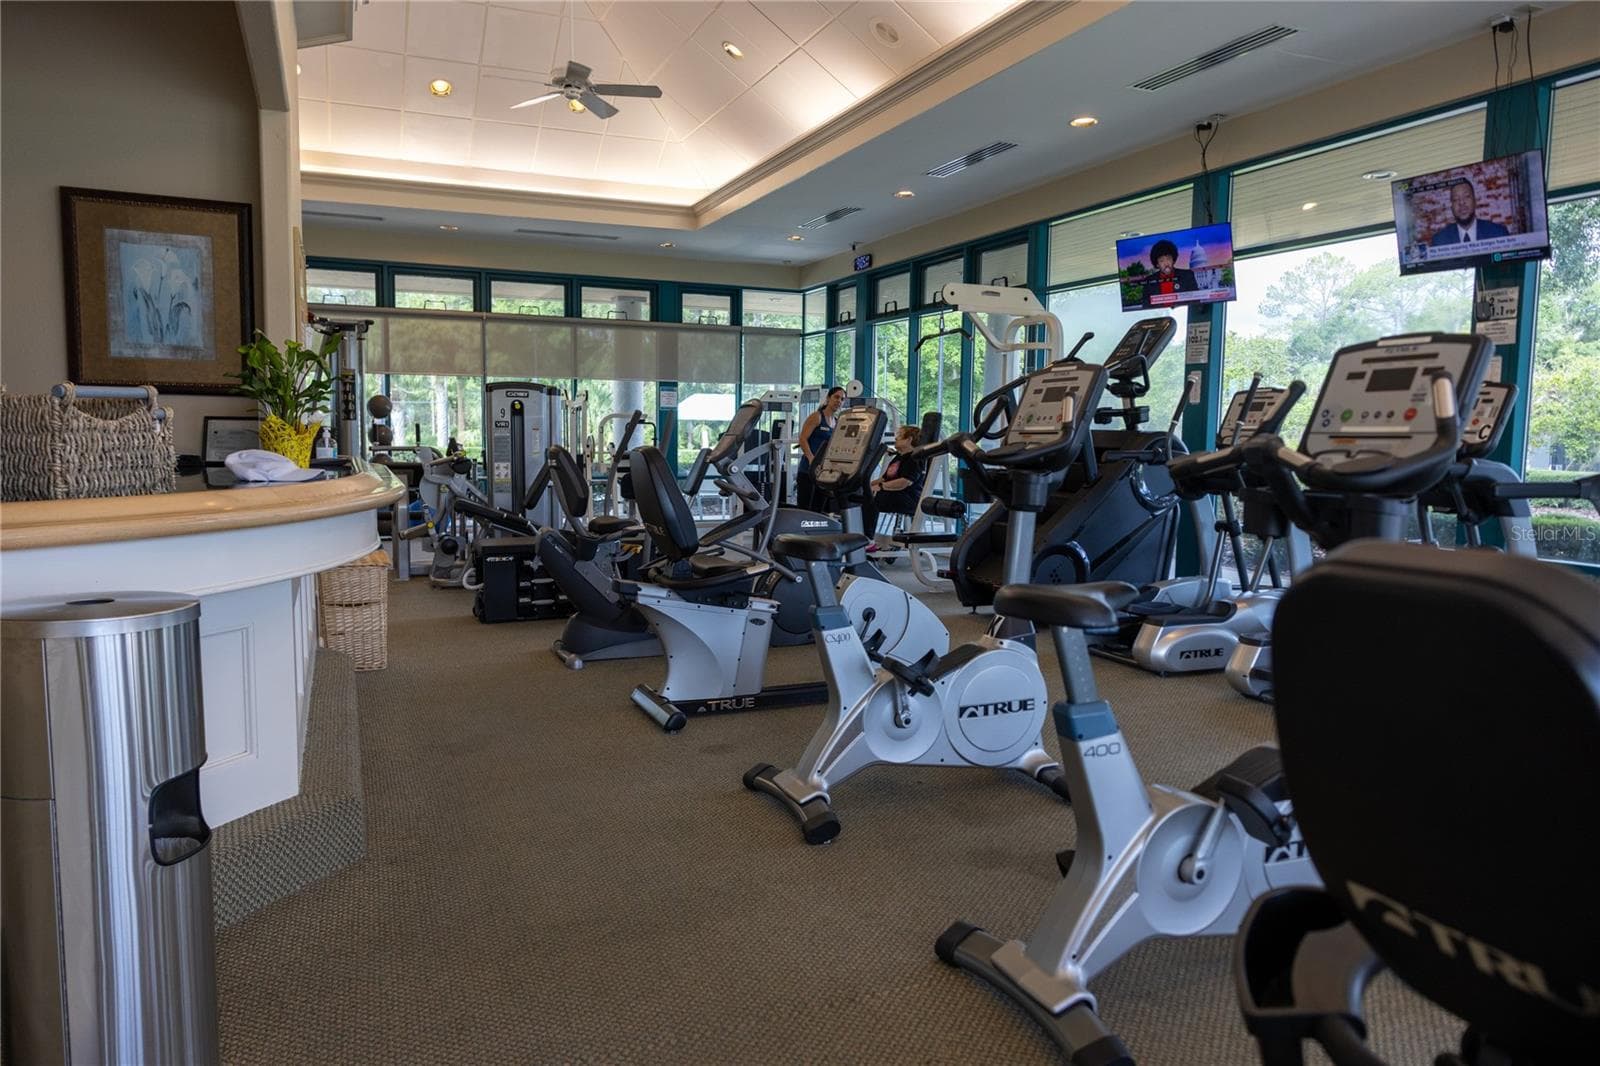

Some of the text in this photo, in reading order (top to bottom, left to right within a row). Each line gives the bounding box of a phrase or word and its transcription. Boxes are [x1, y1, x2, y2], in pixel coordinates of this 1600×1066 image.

[501, 408, 506, 418] 9
[1192, 648, 1225, 659] TRUE
[706, 697, 756, 712] TRUE
[978, 697, 1036, 717] TRUE
[1083, 742, 1121, 757] 400
